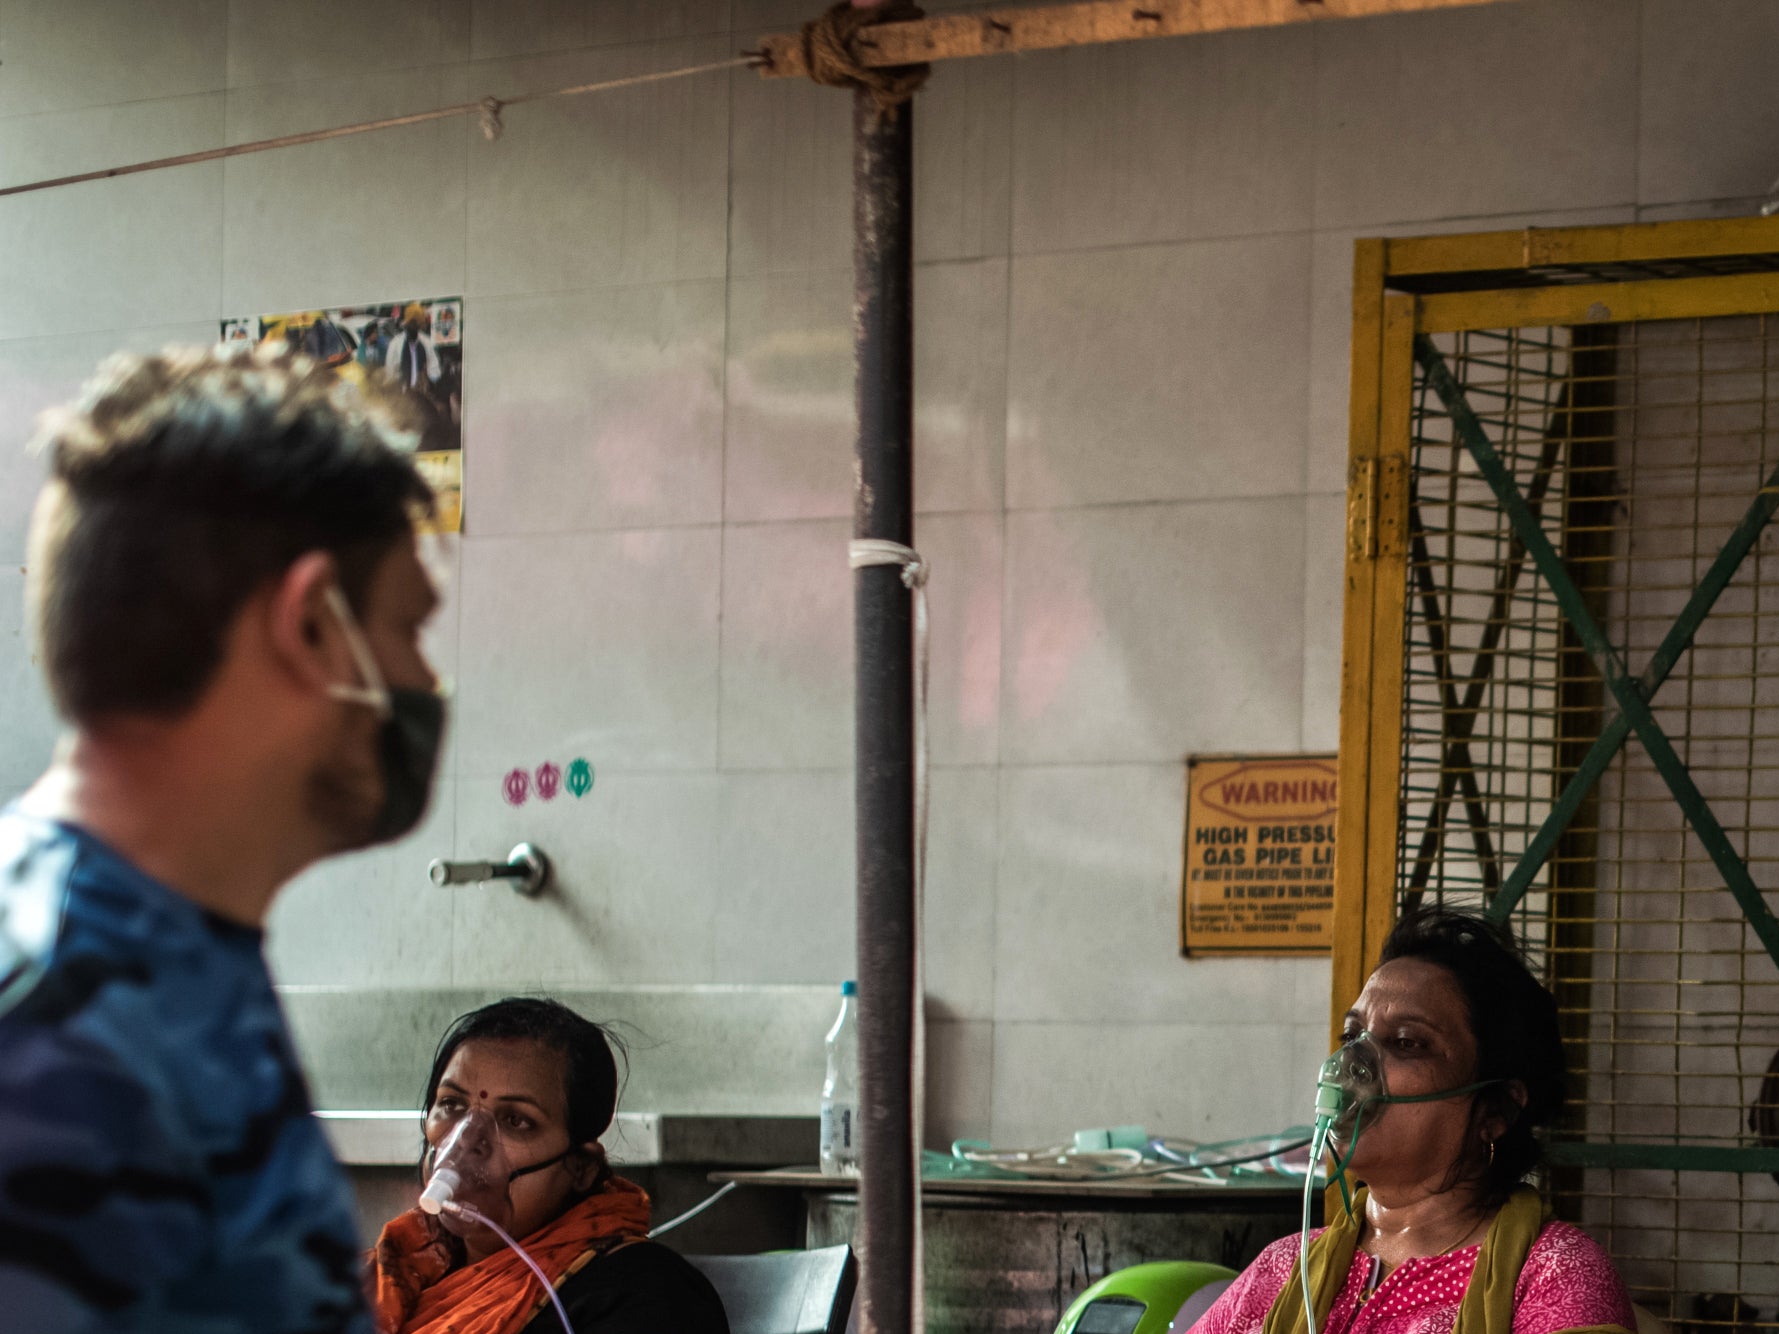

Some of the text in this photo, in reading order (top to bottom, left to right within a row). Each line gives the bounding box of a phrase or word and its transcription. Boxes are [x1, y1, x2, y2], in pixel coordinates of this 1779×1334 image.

[1196, 827, 1247, 844] HIGH
[1203, 848, 1246, 866] GAS
[1256, 847, 1302, 865] PIPE
